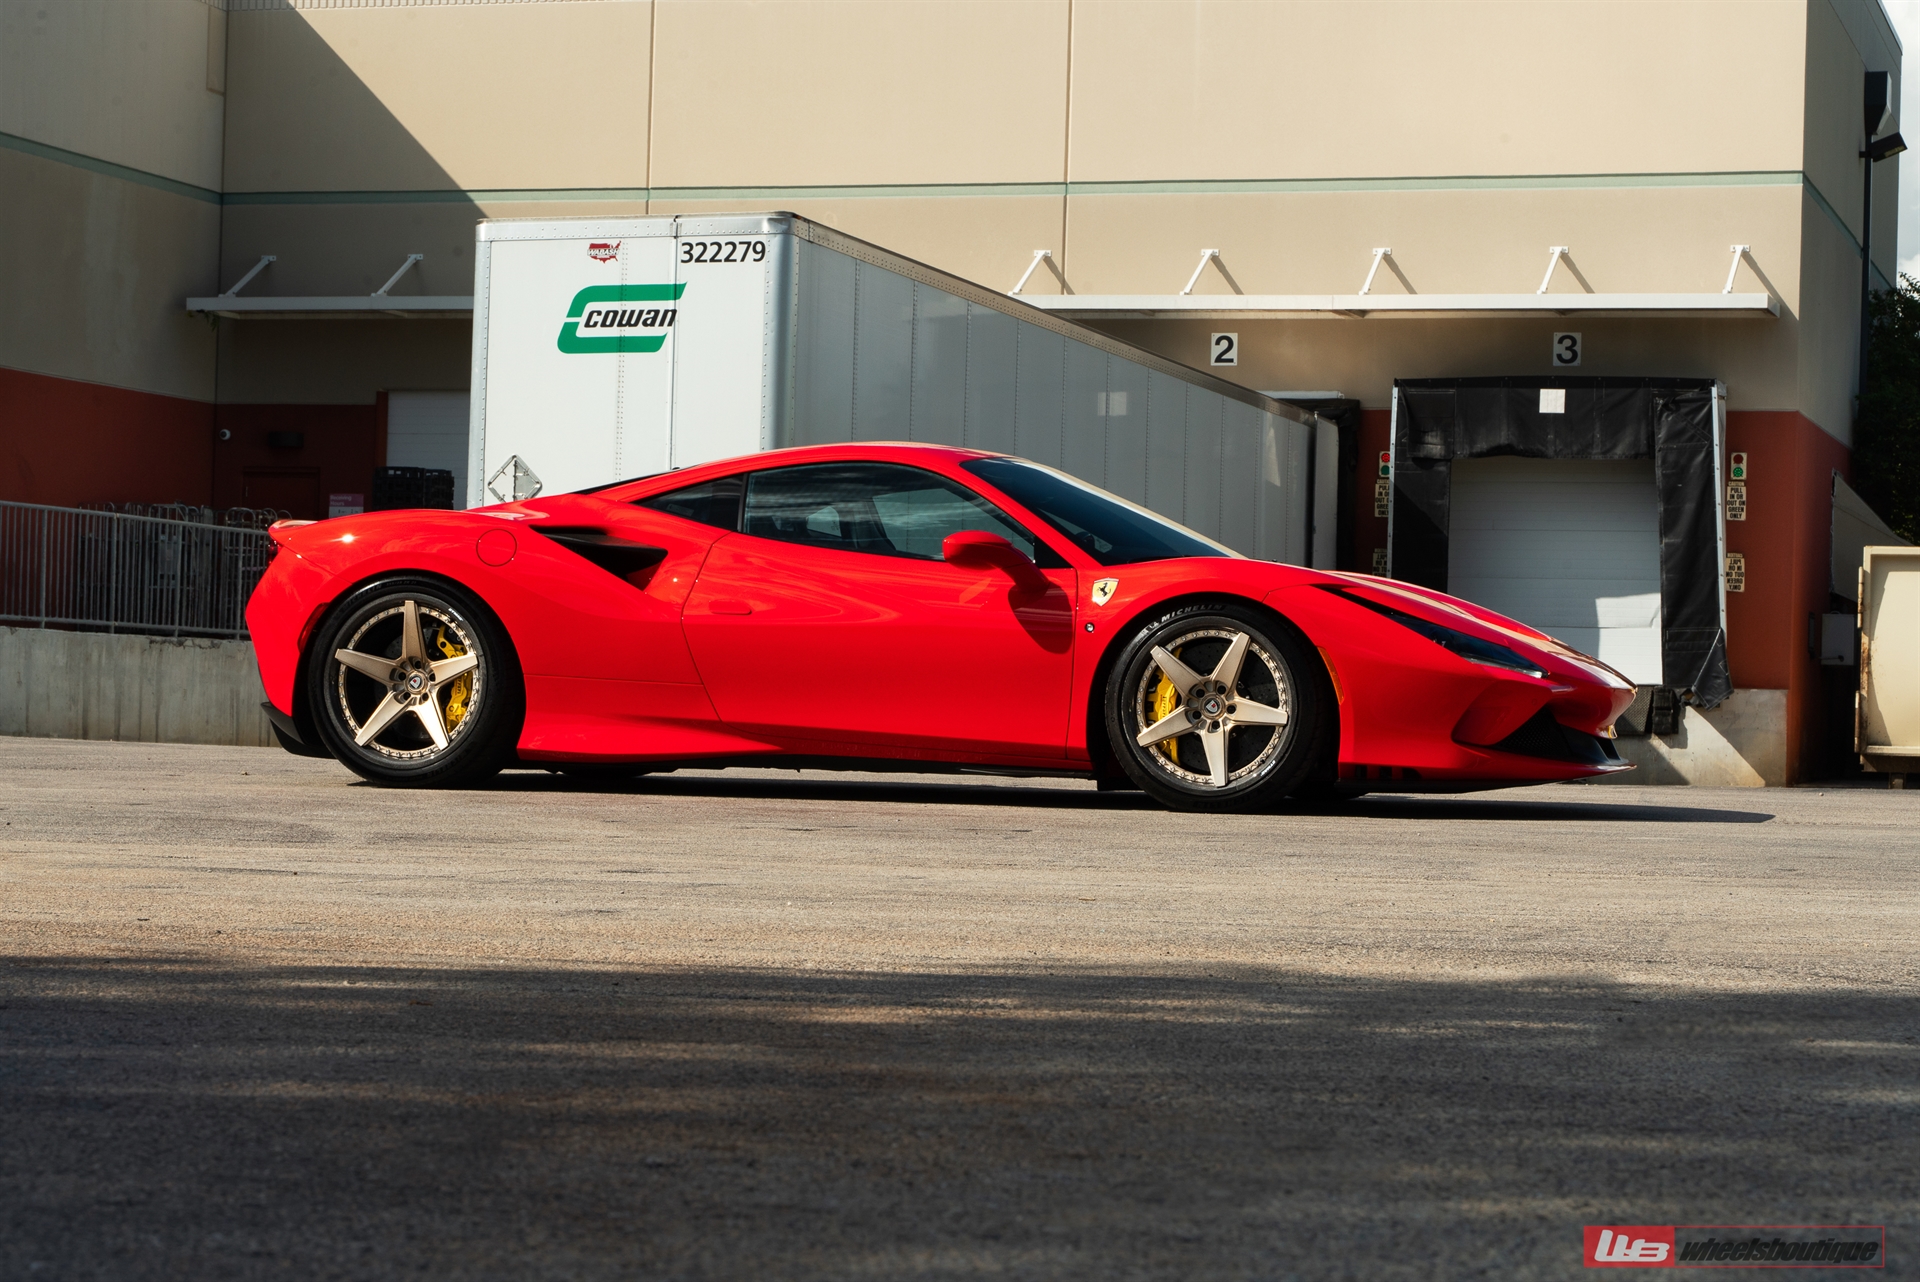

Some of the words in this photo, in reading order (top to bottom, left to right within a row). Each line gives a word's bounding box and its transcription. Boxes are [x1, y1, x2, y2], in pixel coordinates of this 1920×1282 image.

[680, 241, 766, 263] 322279
[1214, 335, 1234, 363] 2
[1556, 335, 1578, 364] 3
[1161, 604, 1222, 622] MICHELIN
